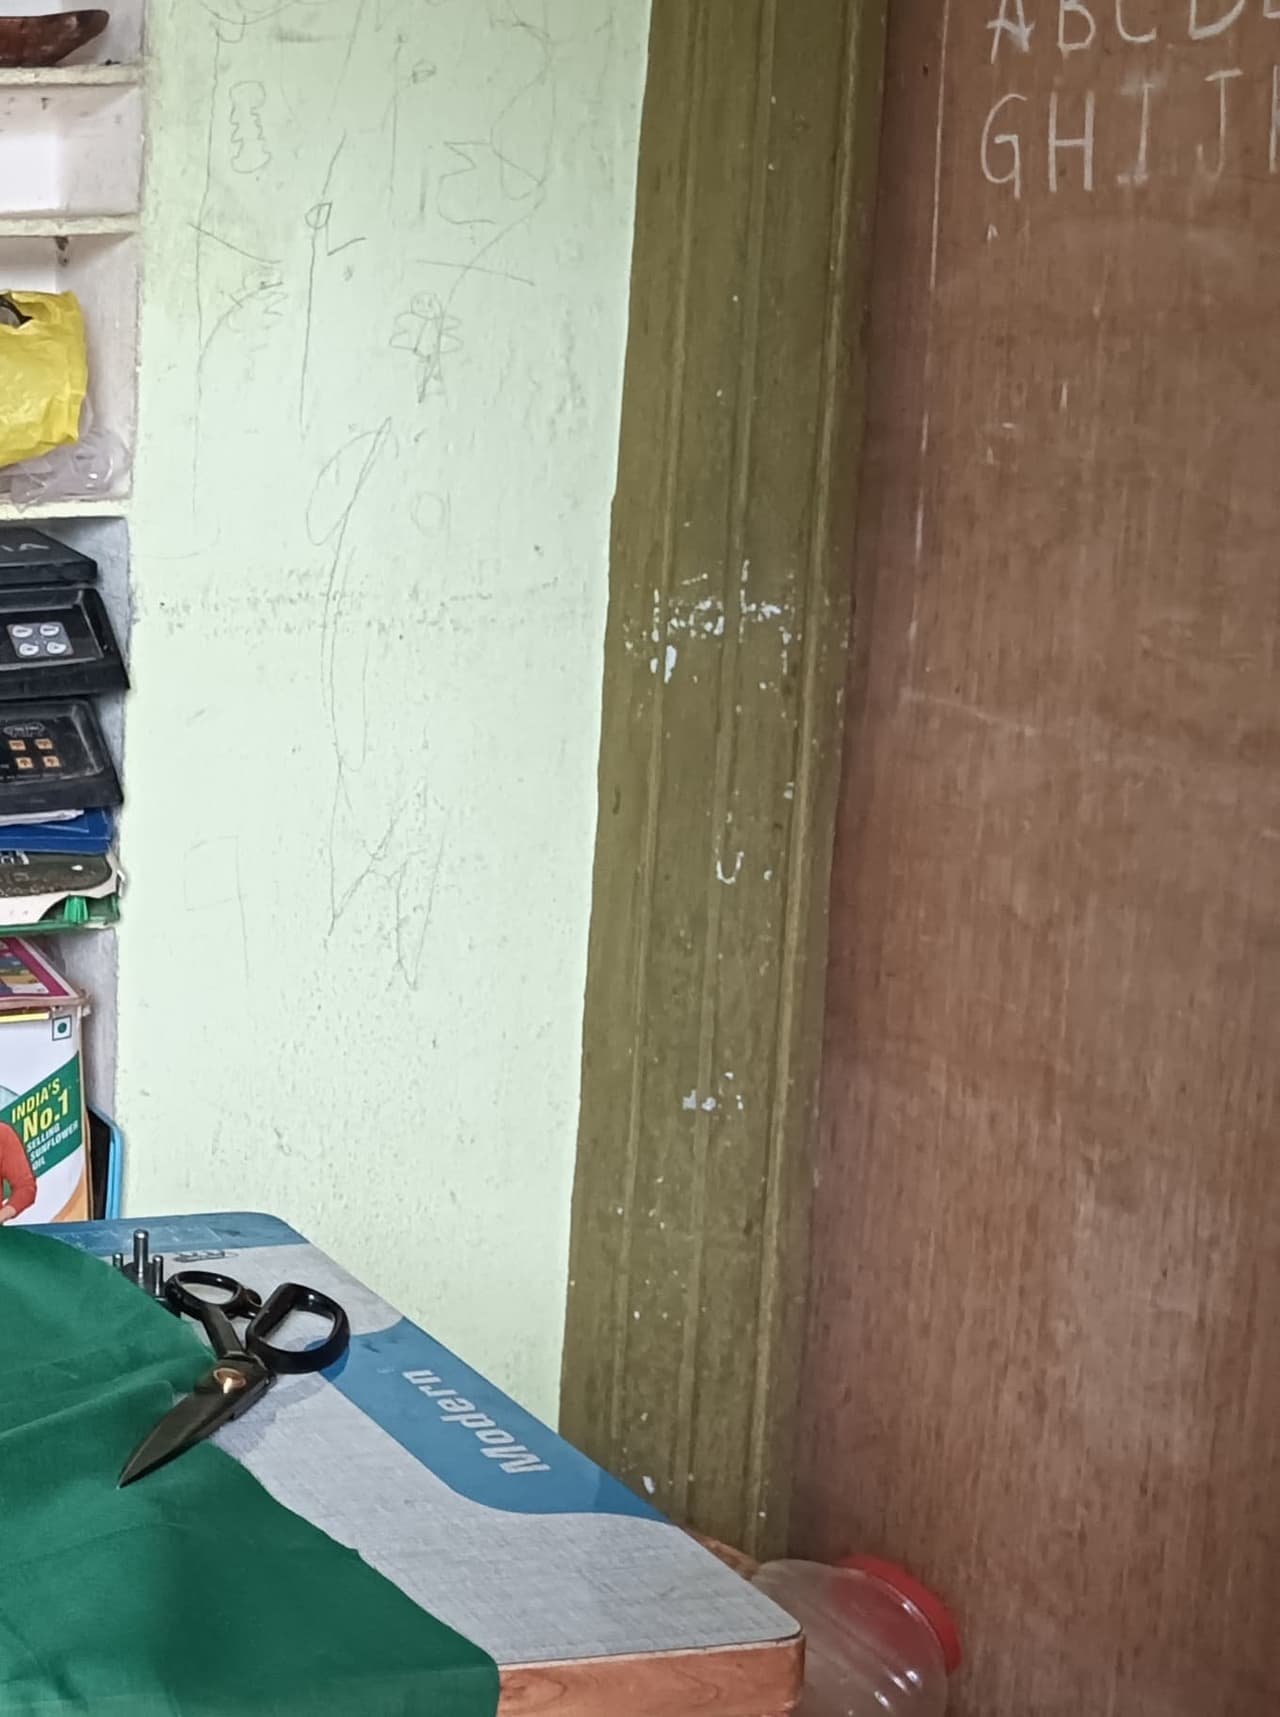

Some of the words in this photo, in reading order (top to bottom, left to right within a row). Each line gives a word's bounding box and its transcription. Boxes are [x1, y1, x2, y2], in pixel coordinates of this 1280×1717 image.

[12, 1078, 60, 1124] INDIA'S
[27, 1122, 60, 1153] SELLING
[30, 1119, 79, 1162] SUNFLOWER
[402, 1369, 552, 1474] Modern
